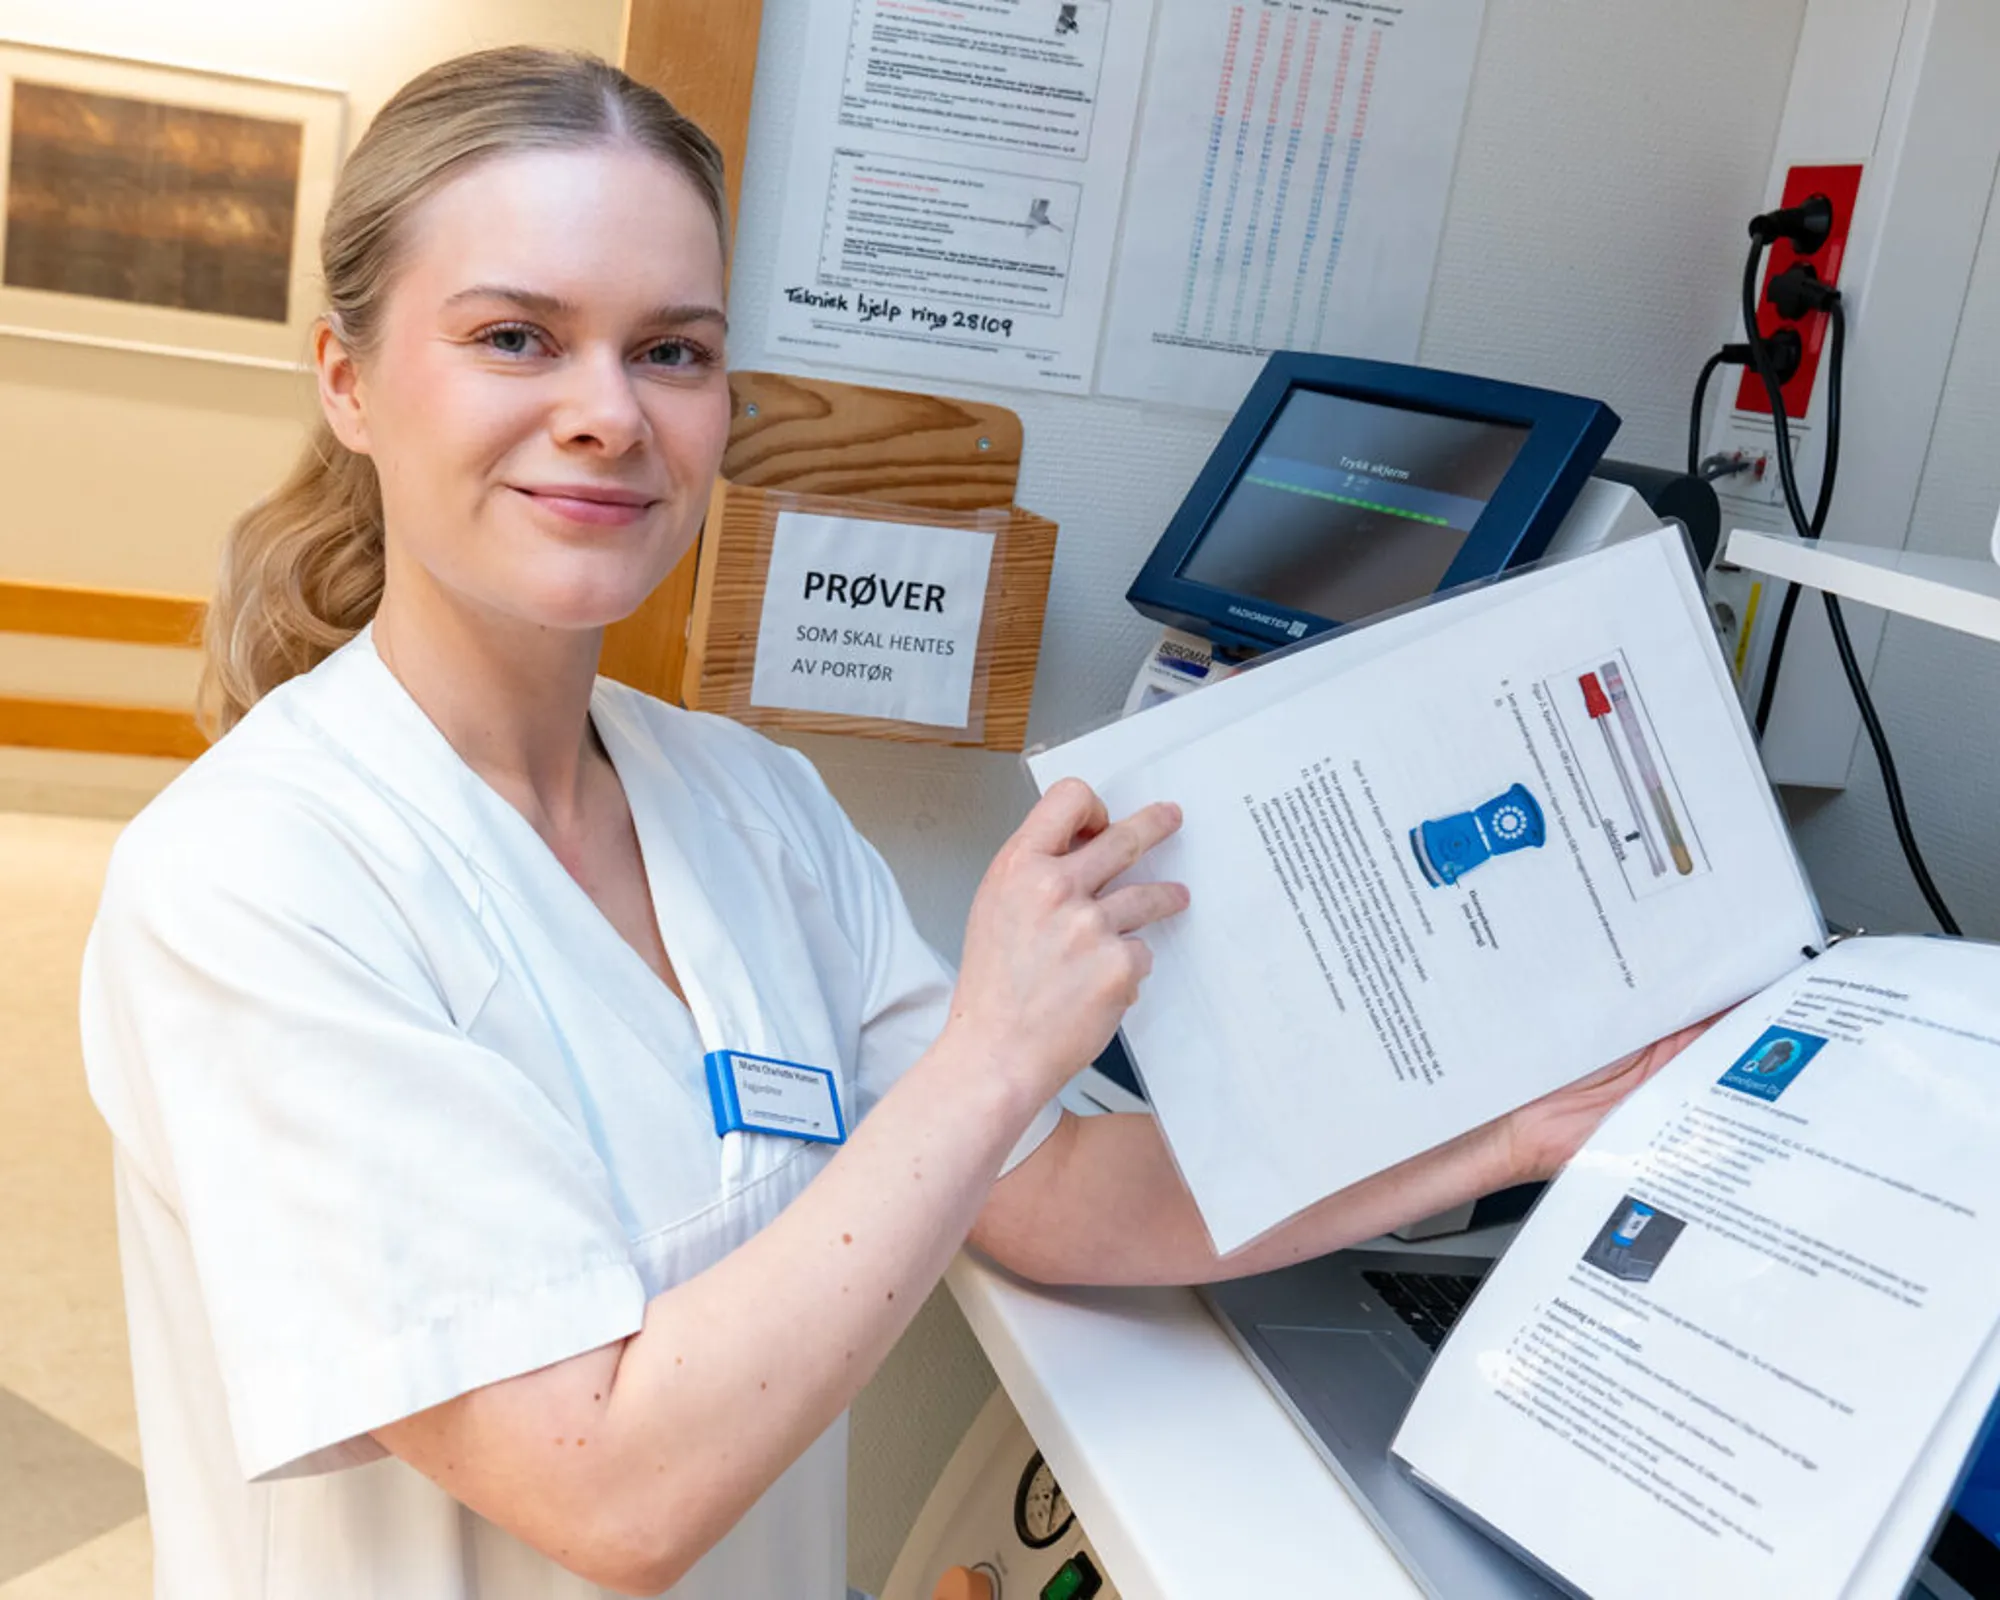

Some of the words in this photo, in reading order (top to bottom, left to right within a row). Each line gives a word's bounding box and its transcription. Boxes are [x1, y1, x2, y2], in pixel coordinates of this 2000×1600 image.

[858, 293, 902, 322] hjelp
[911, 306, 948, 331] ring
[952, 310, 1013, 338] 28109
[1340, 455, 1370, 471] Trykk
[803, 571, 946, 613] PRØVER
[1228, 605, 1290, 631] RADIOMETER
[796, 625, 838, 646] SOM
[843, 630, 884, 649] SKAL
[889, 633, 955, 656] HENTES
[791, 659, 817, 675] AV
[821, 662, 893, 682] PORTØR
